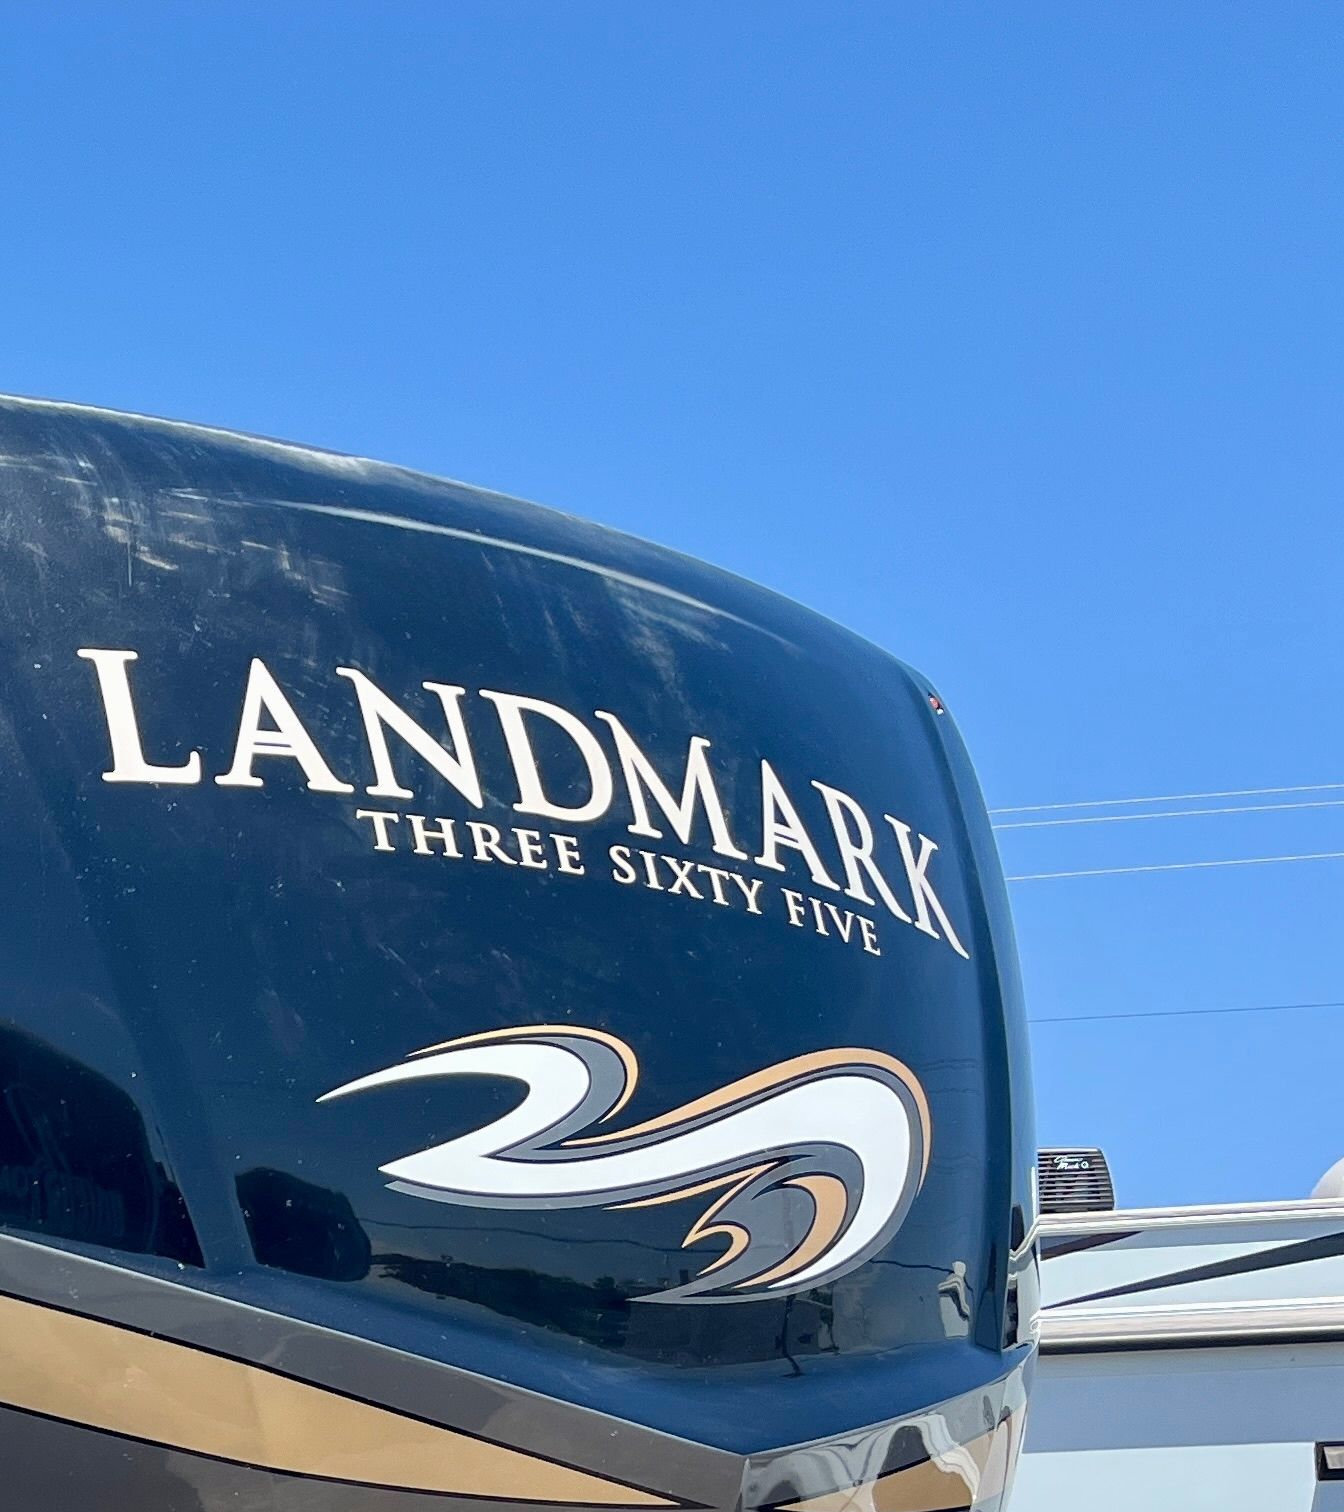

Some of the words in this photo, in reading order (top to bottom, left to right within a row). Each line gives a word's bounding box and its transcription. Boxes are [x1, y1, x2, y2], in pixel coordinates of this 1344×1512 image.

[76, 648, 970, 960] LANDMARK
[356, 807, 586, 876] THREE
[609, 844, 765, 916] SIXTY
[780, 886, 882, 957] FIVE
